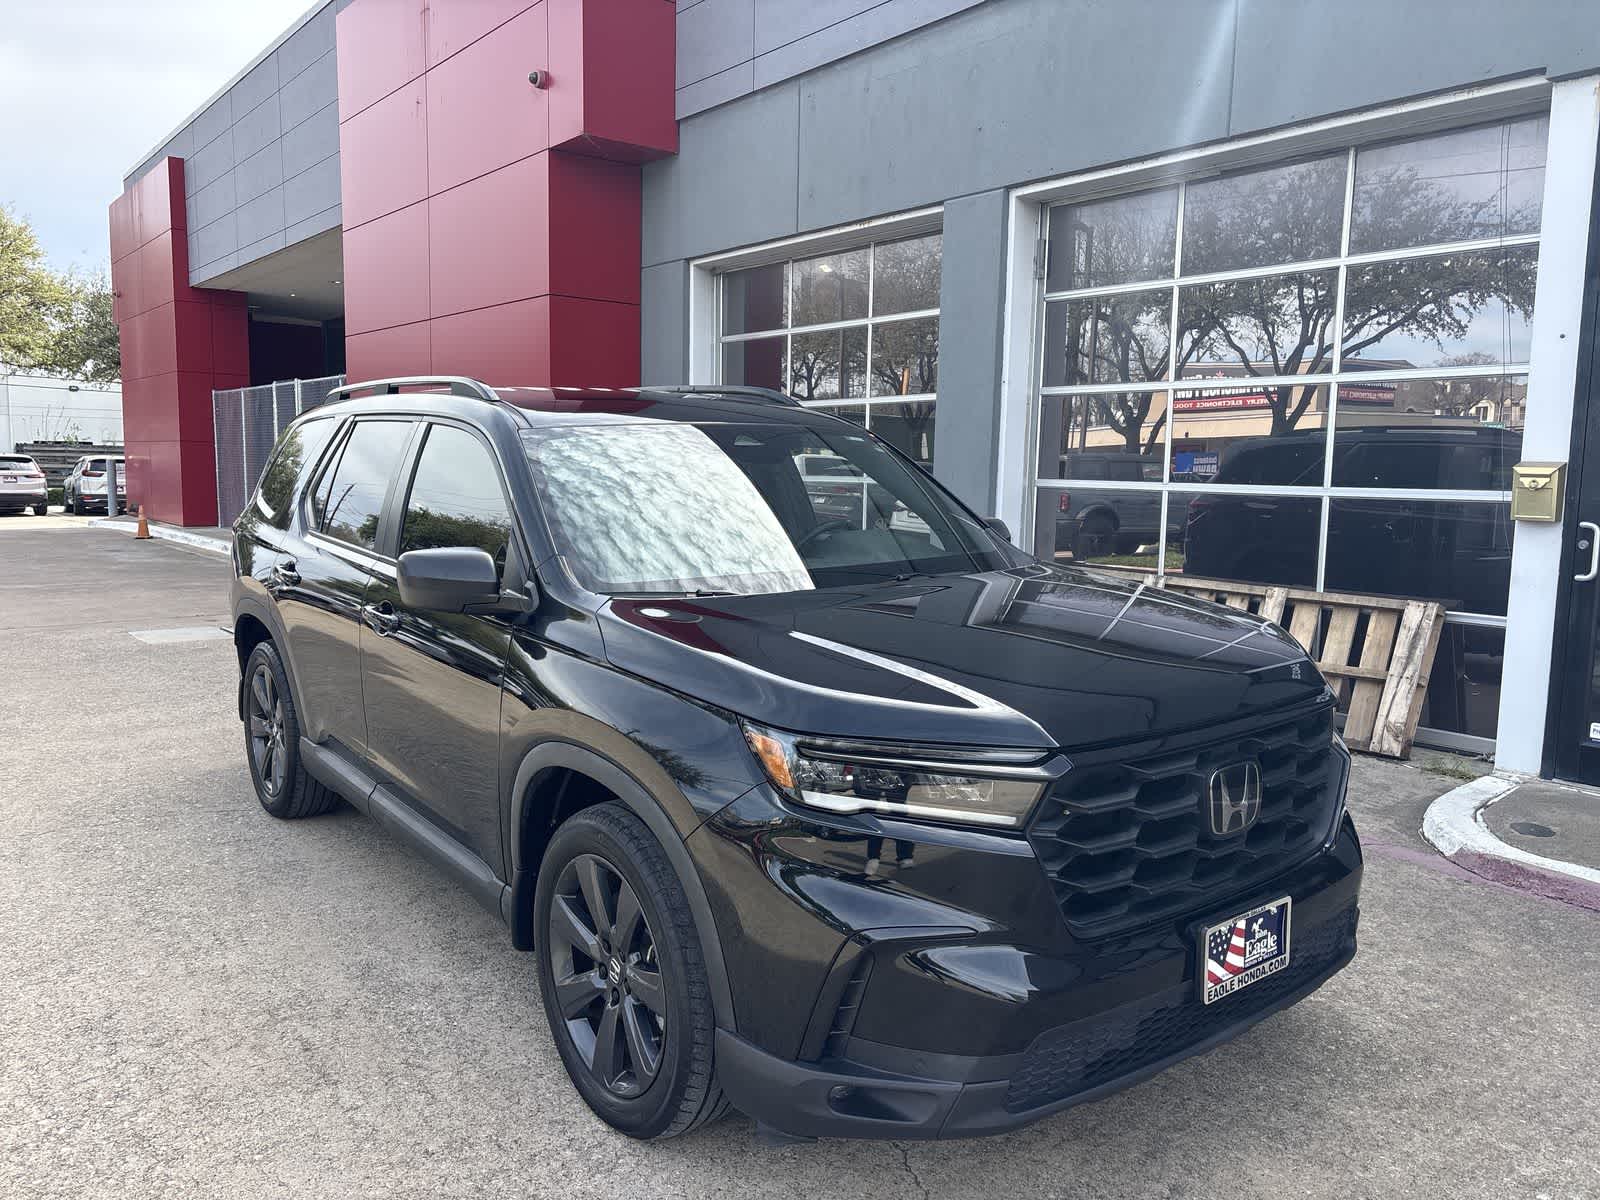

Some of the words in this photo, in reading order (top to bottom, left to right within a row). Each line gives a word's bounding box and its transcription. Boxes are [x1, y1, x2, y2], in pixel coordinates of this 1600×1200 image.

[1245, 931, 1277, 957] Eagle
[1207, 979, 1236, 1002] EAGLE
[1237, 956, 1287, 988] HONDA.COM
